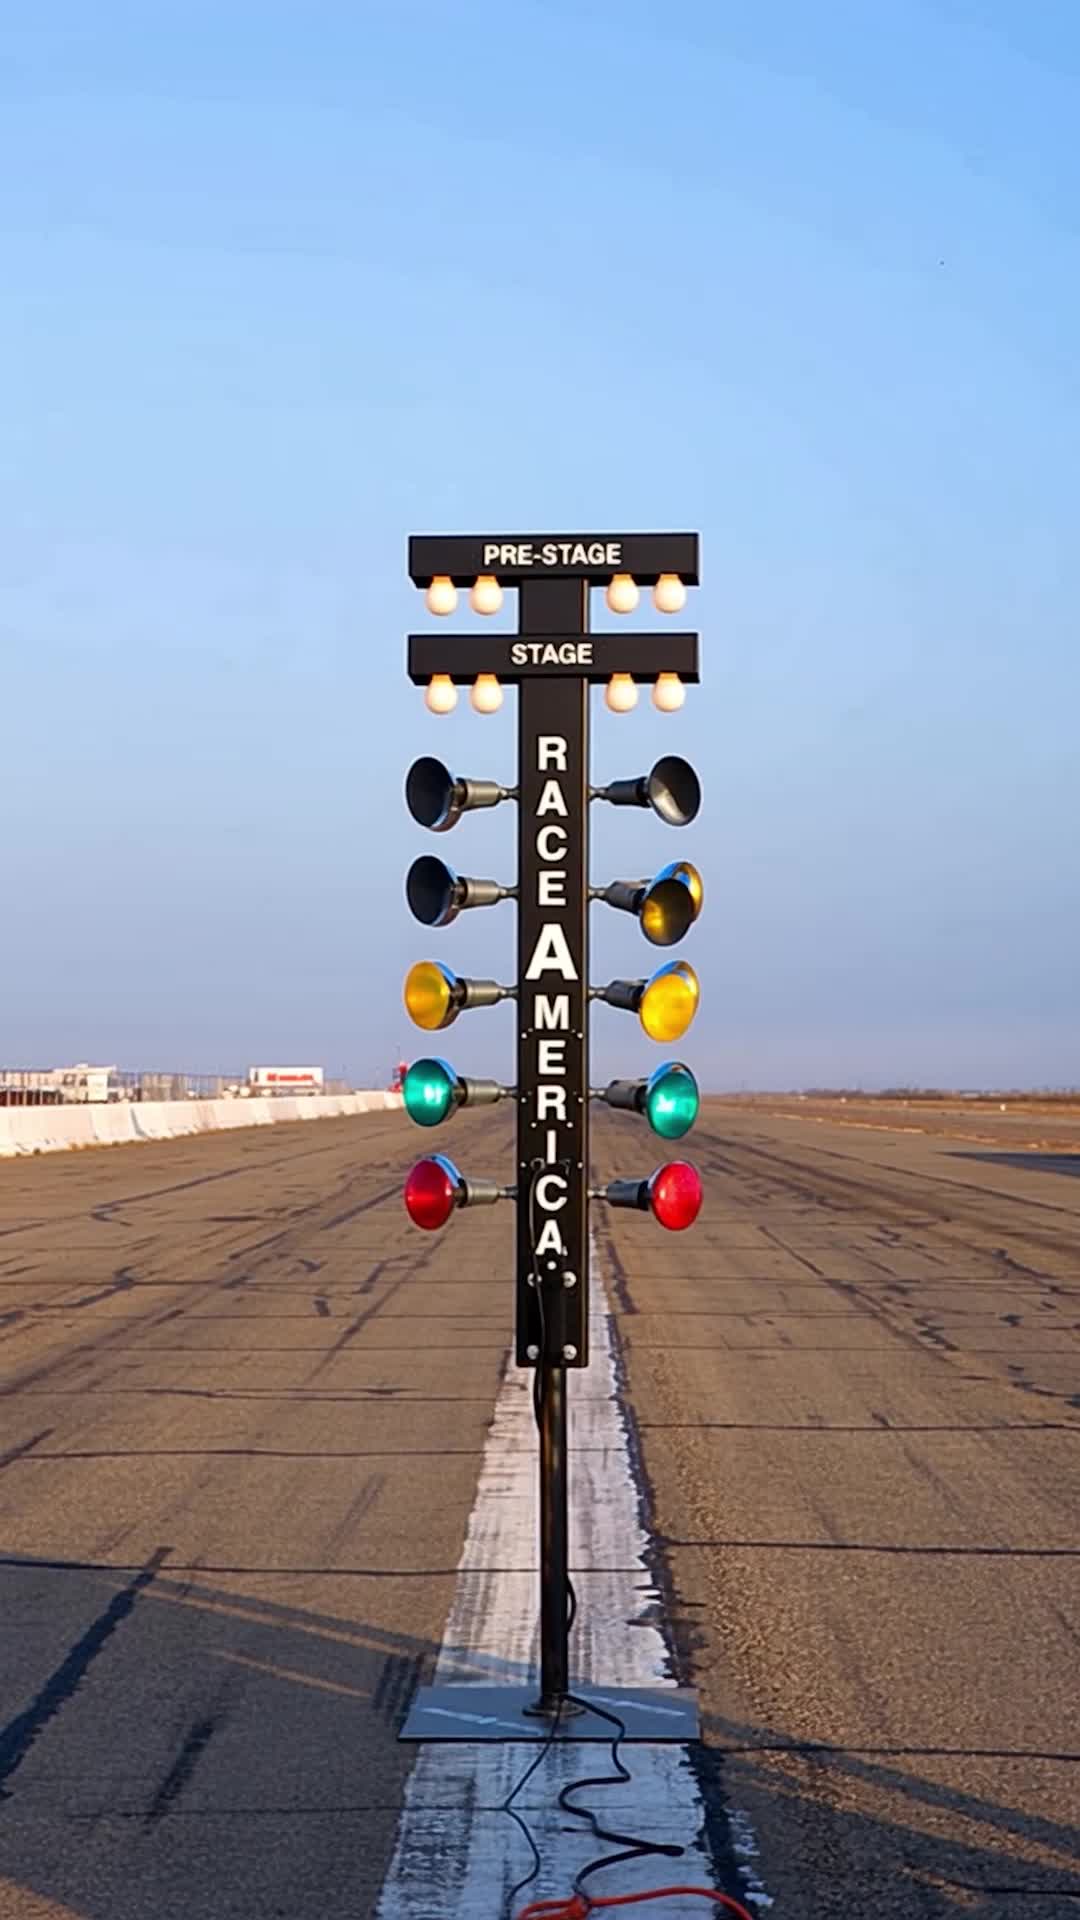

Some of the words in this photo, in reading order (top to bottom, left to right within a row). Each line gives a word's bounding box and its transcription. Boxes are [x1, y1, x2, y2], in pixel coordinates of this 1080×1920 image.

[483, 543, 622, 566] PRE-STAGE
[511, 643, 593, 665] STAGE
[536, 735, 568, 907] RACE
[525, 923, 578, 1256] AMERICA
